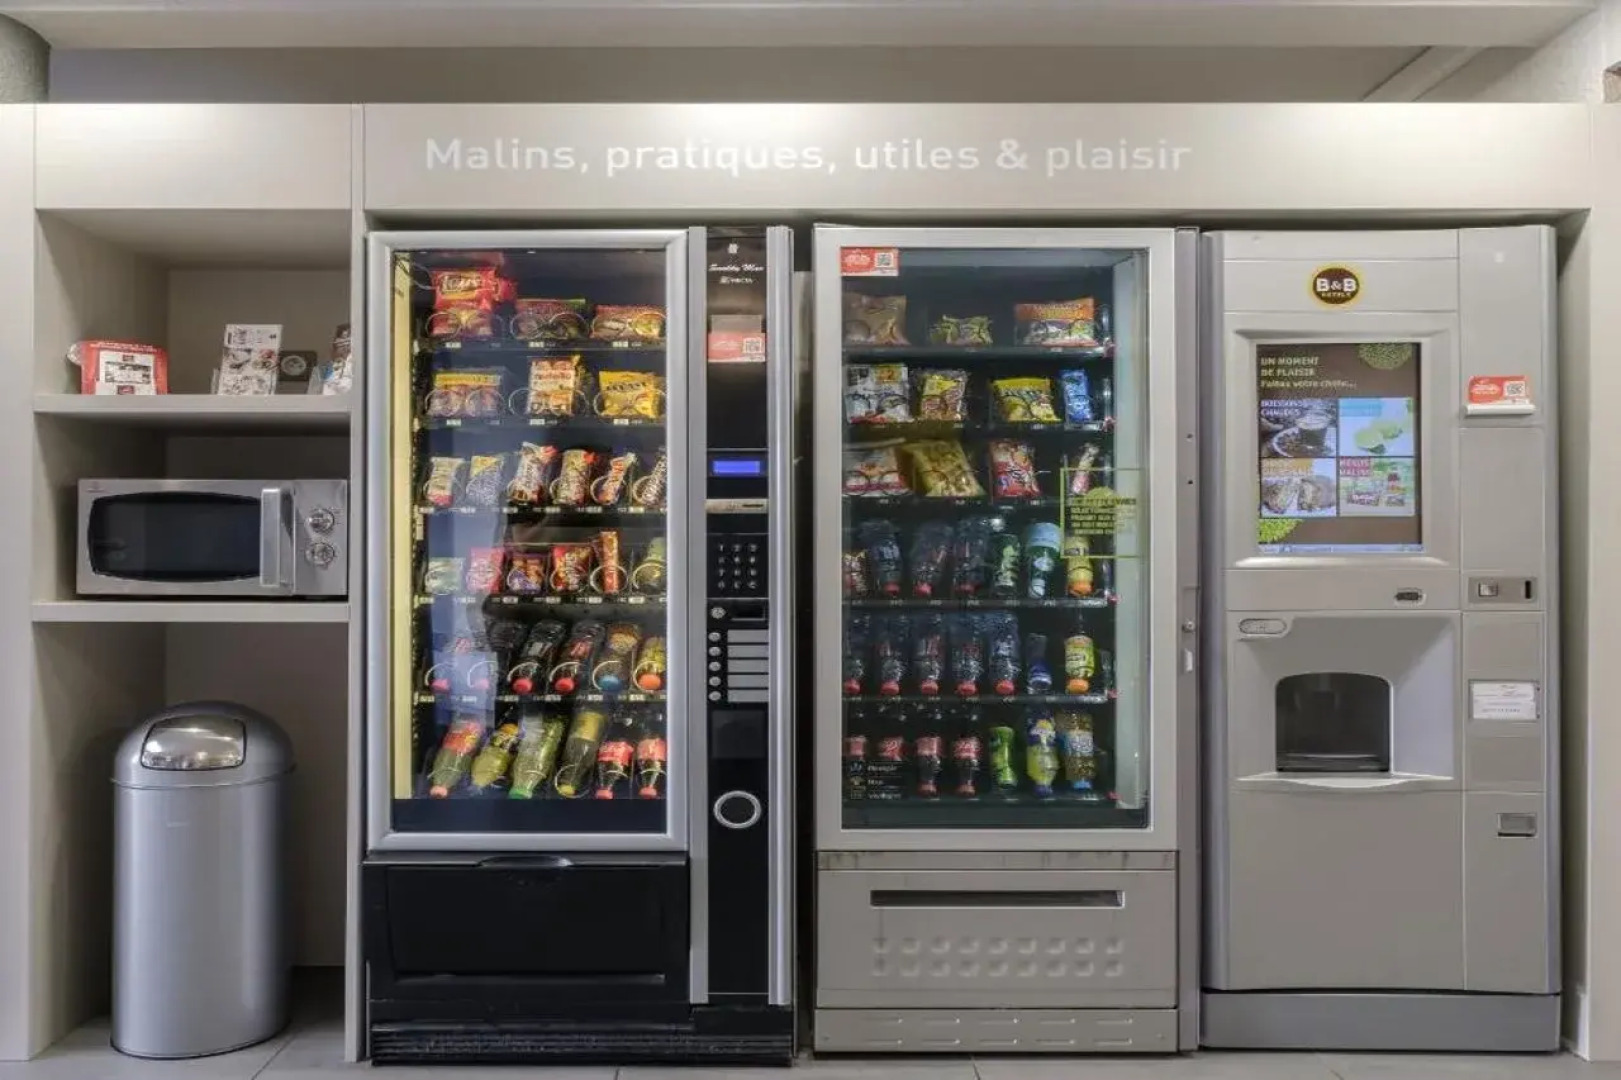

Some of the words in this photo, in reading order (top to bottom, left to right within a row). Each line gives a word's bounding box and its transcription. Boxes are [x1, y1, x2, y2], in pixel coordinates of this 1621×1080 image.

[426, 138, 589, 174] Malins,
[607, 138, 837, 177] pratiques,
[854, 138, 980, 170] utiles
[995, 138, 1028, 170] &
[1046, 138, 1193, 177] plaisir
[1316, 278, 1357, 291] B&B
